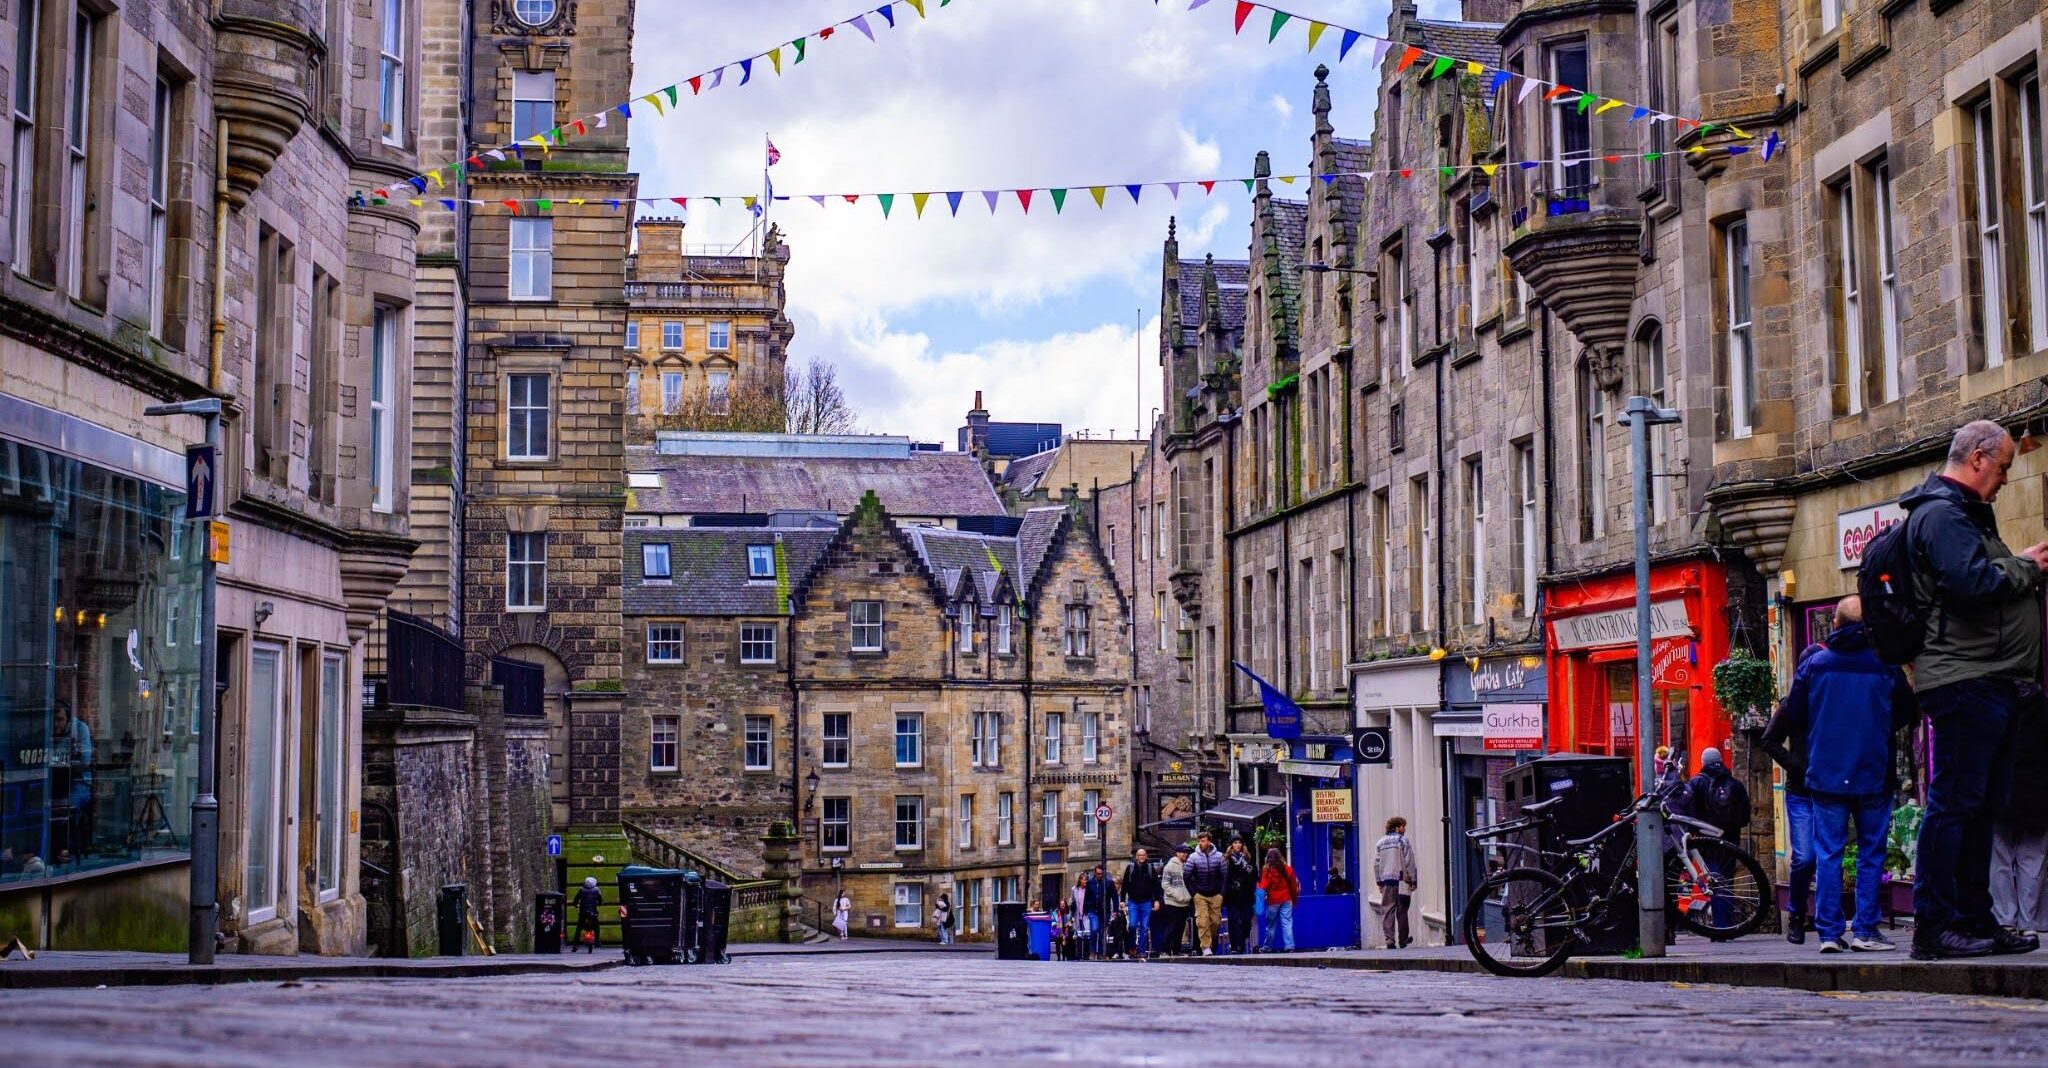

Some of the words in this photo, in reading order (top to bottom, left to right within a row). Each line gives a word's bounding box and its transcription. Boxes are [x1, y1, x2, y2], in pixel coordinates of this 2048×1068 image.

[1582, 611, 1638, 641] ARMSTRONG
[1487, 713, 1540, 728] Gurkha
[1316, 798, 1345, 806] BREAKFAST
[1334, 812, 1351, 820] GOODS
